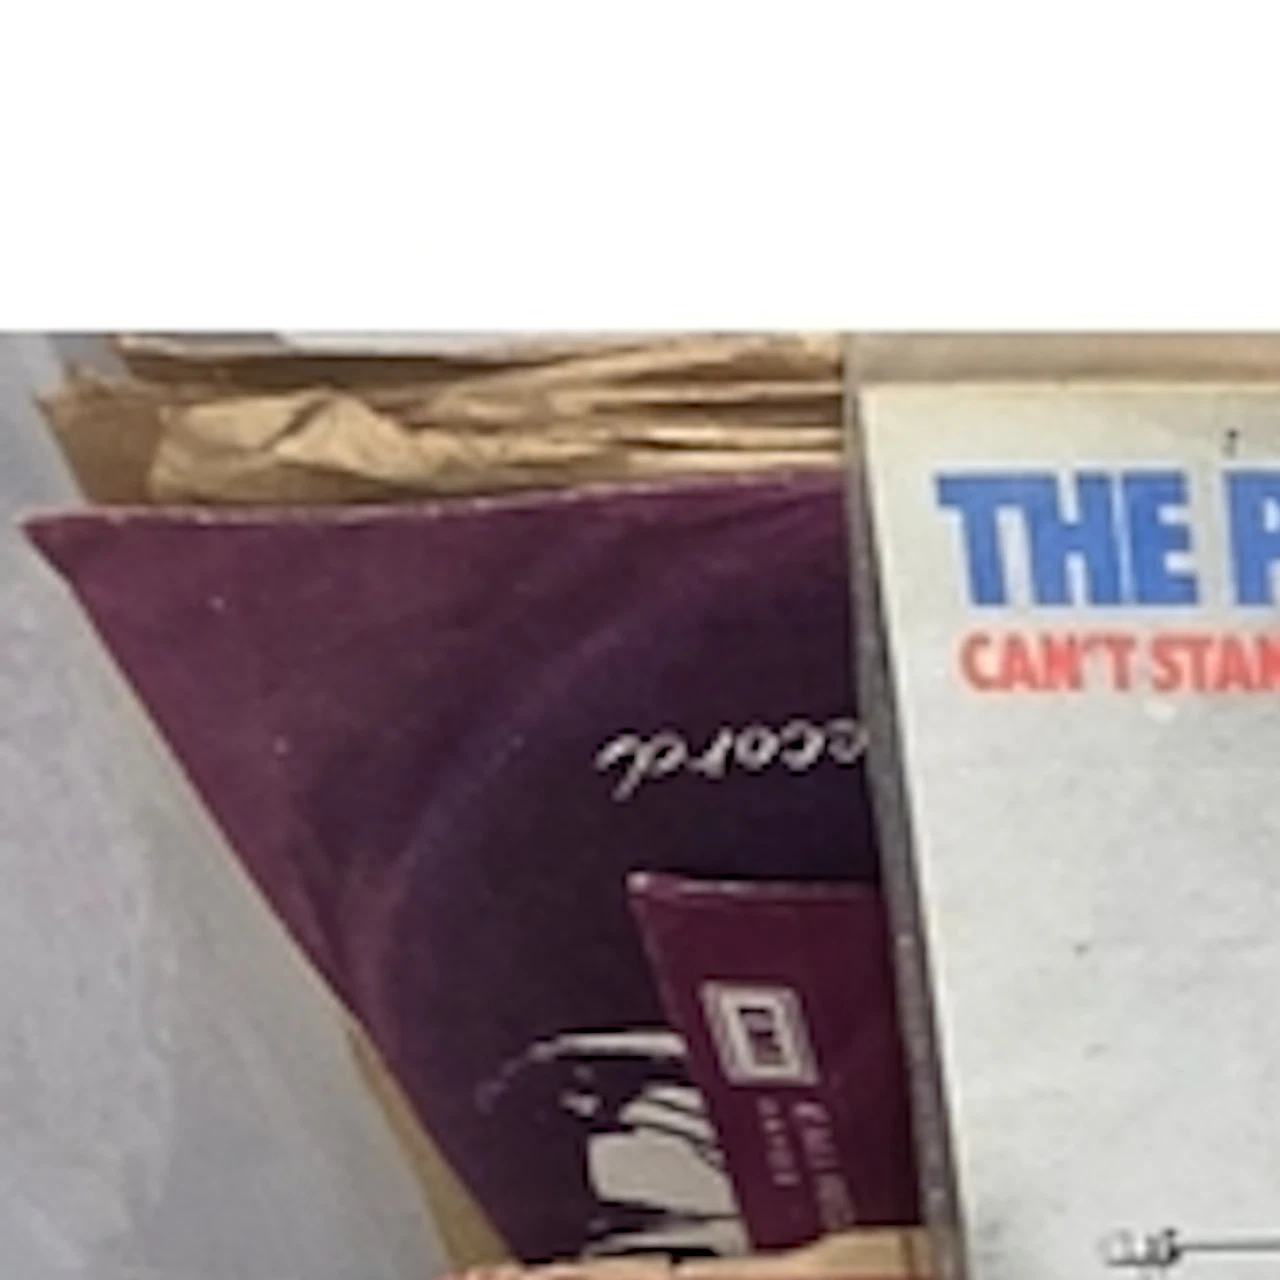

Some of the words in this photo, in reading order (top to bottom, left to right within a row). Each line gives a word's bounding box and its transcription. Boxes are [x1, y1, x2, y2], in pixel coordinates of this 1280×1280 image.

[935, 467, 1198, 608] THE
[961, 632, 1136, 693] CAN'T
[597, 720, 868, 800] ecords
